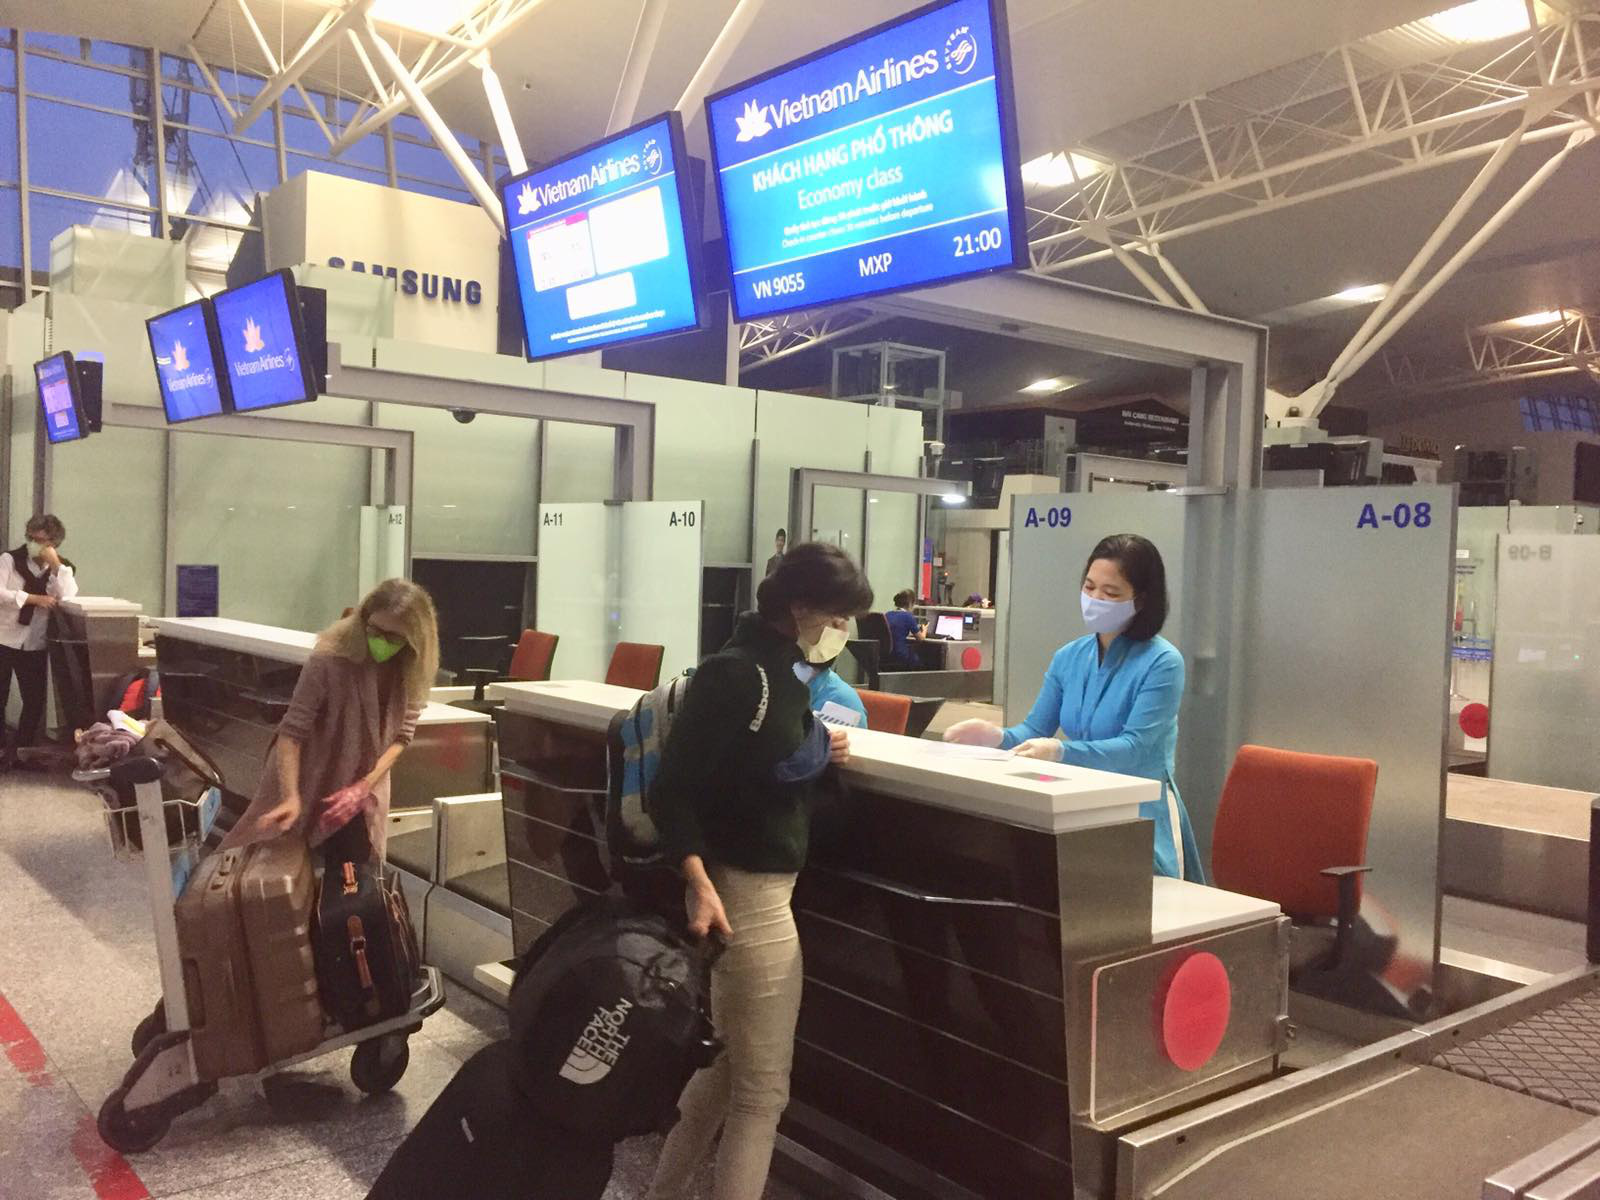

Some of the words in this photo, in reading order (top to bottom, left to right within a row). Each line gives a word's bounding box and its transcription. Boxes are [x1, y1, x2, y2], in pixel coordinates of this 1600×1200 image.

[752, 159, 801, 192] KHÁCH
[888, 109, 954, 149] THÔNG
[797, 177, 863, 209] Economy
[866, 165, 903, 190] class
[953, 227, 1002, 257] 21:00
[858, 252, 893, 277] MXP
[752, 280, 772, 299] VN
[773, 272, 805, 296] 9055
[388, 513, 403, 525] A-12
[543, 513, 563, 526] A-11
[669, 511, 695, 527] A-10
[1024, 507, 1072, 528] A-09
[1356, 502, 1431, 528] A-08
[749, 663, 769, 732] Babolat
[576, 1005, 612, 1051] FACE
[587, 997, 633, 1060] NORTH
[602, 1033, 632, 1066] THE
